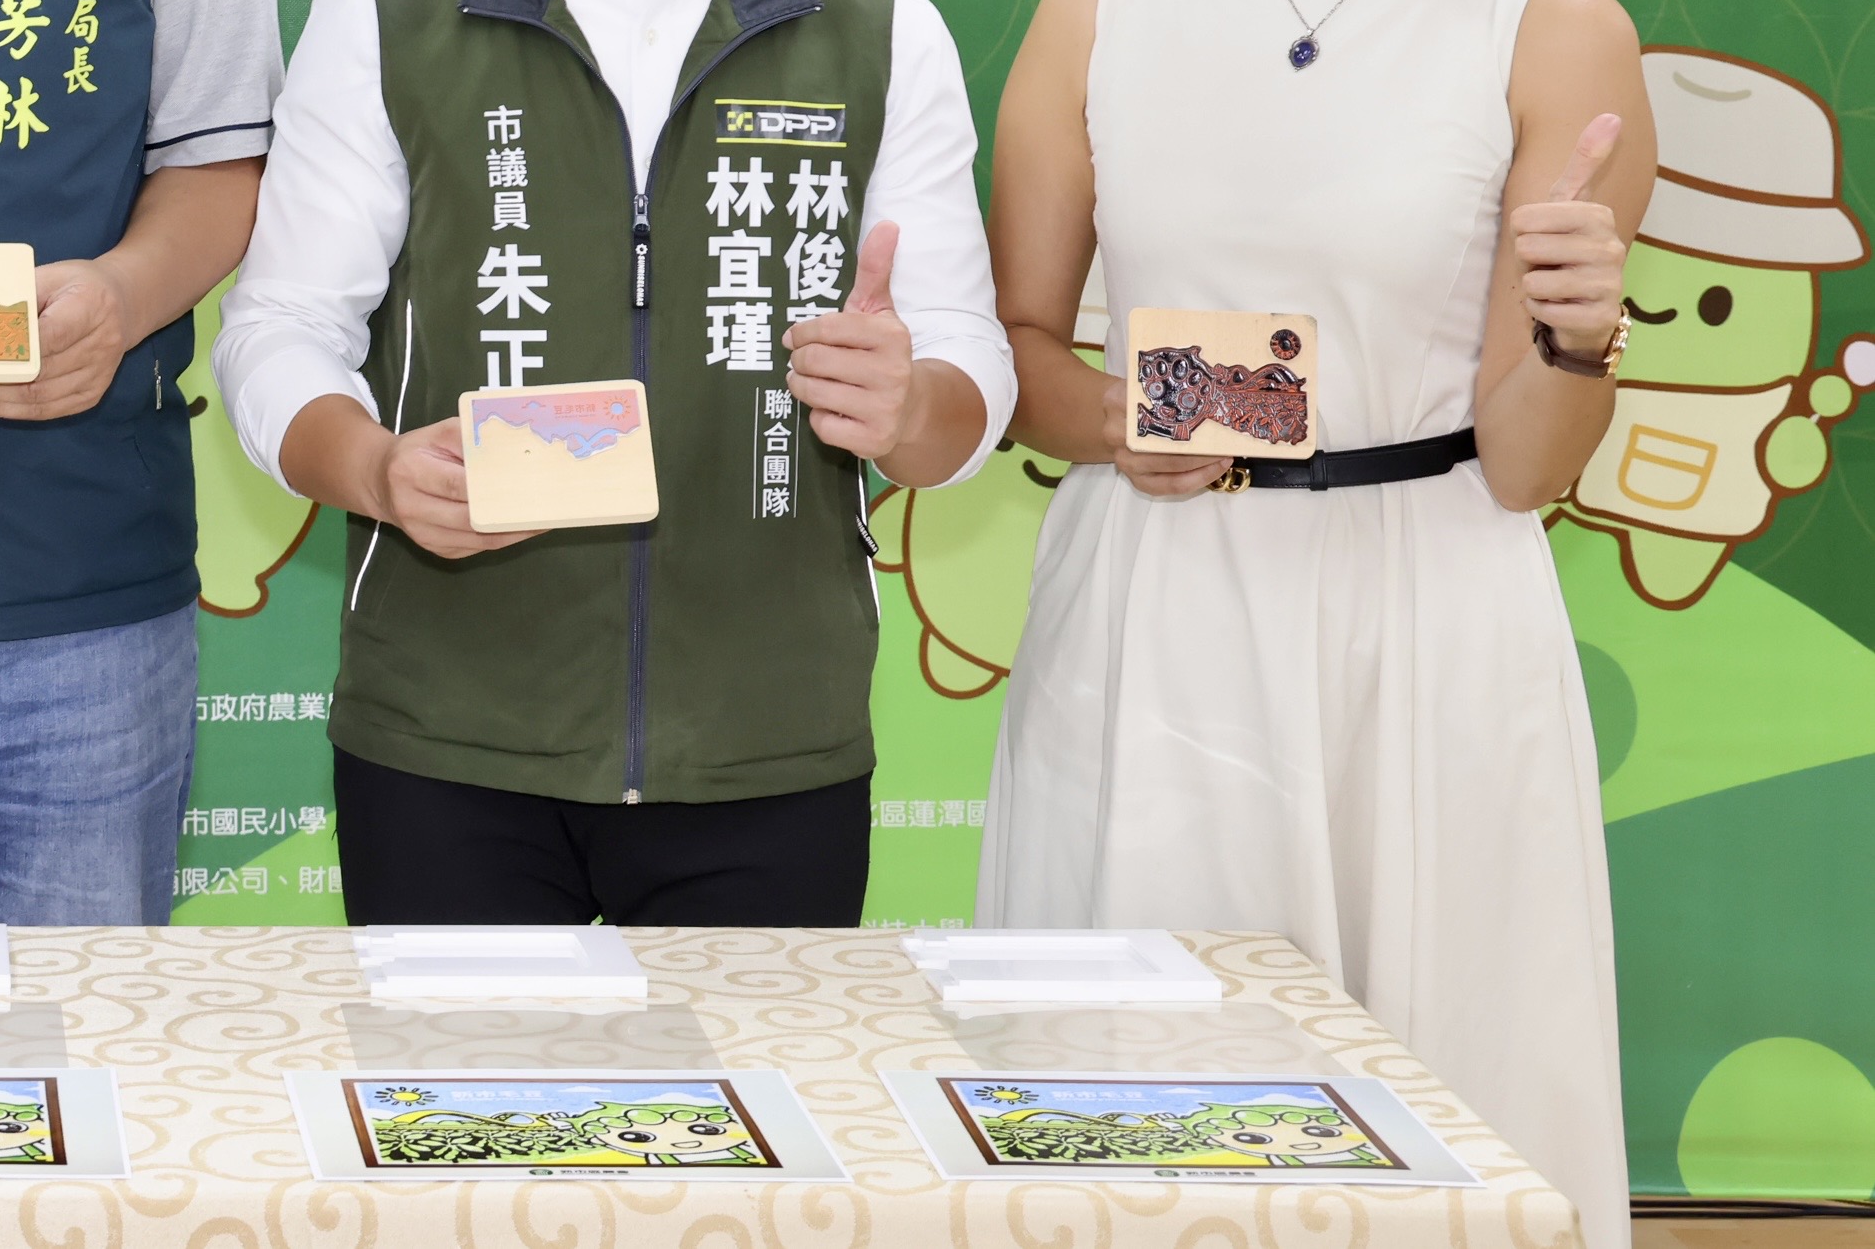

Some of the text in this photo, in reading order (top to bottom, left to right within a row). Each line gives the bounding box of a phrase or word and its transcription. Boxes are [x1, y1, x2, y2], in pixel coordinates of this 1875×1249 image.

[757, 111, 837, 135] DPP
[483, 104, 531, 231] 市議員
[705, 156, 775, 372] 林宜瑾
[761, 388, 793, 519] 聯合團隊
[183, 806, 327, 836] 市國民小學
[871, 800, 987, 828] 區蓮潭國
